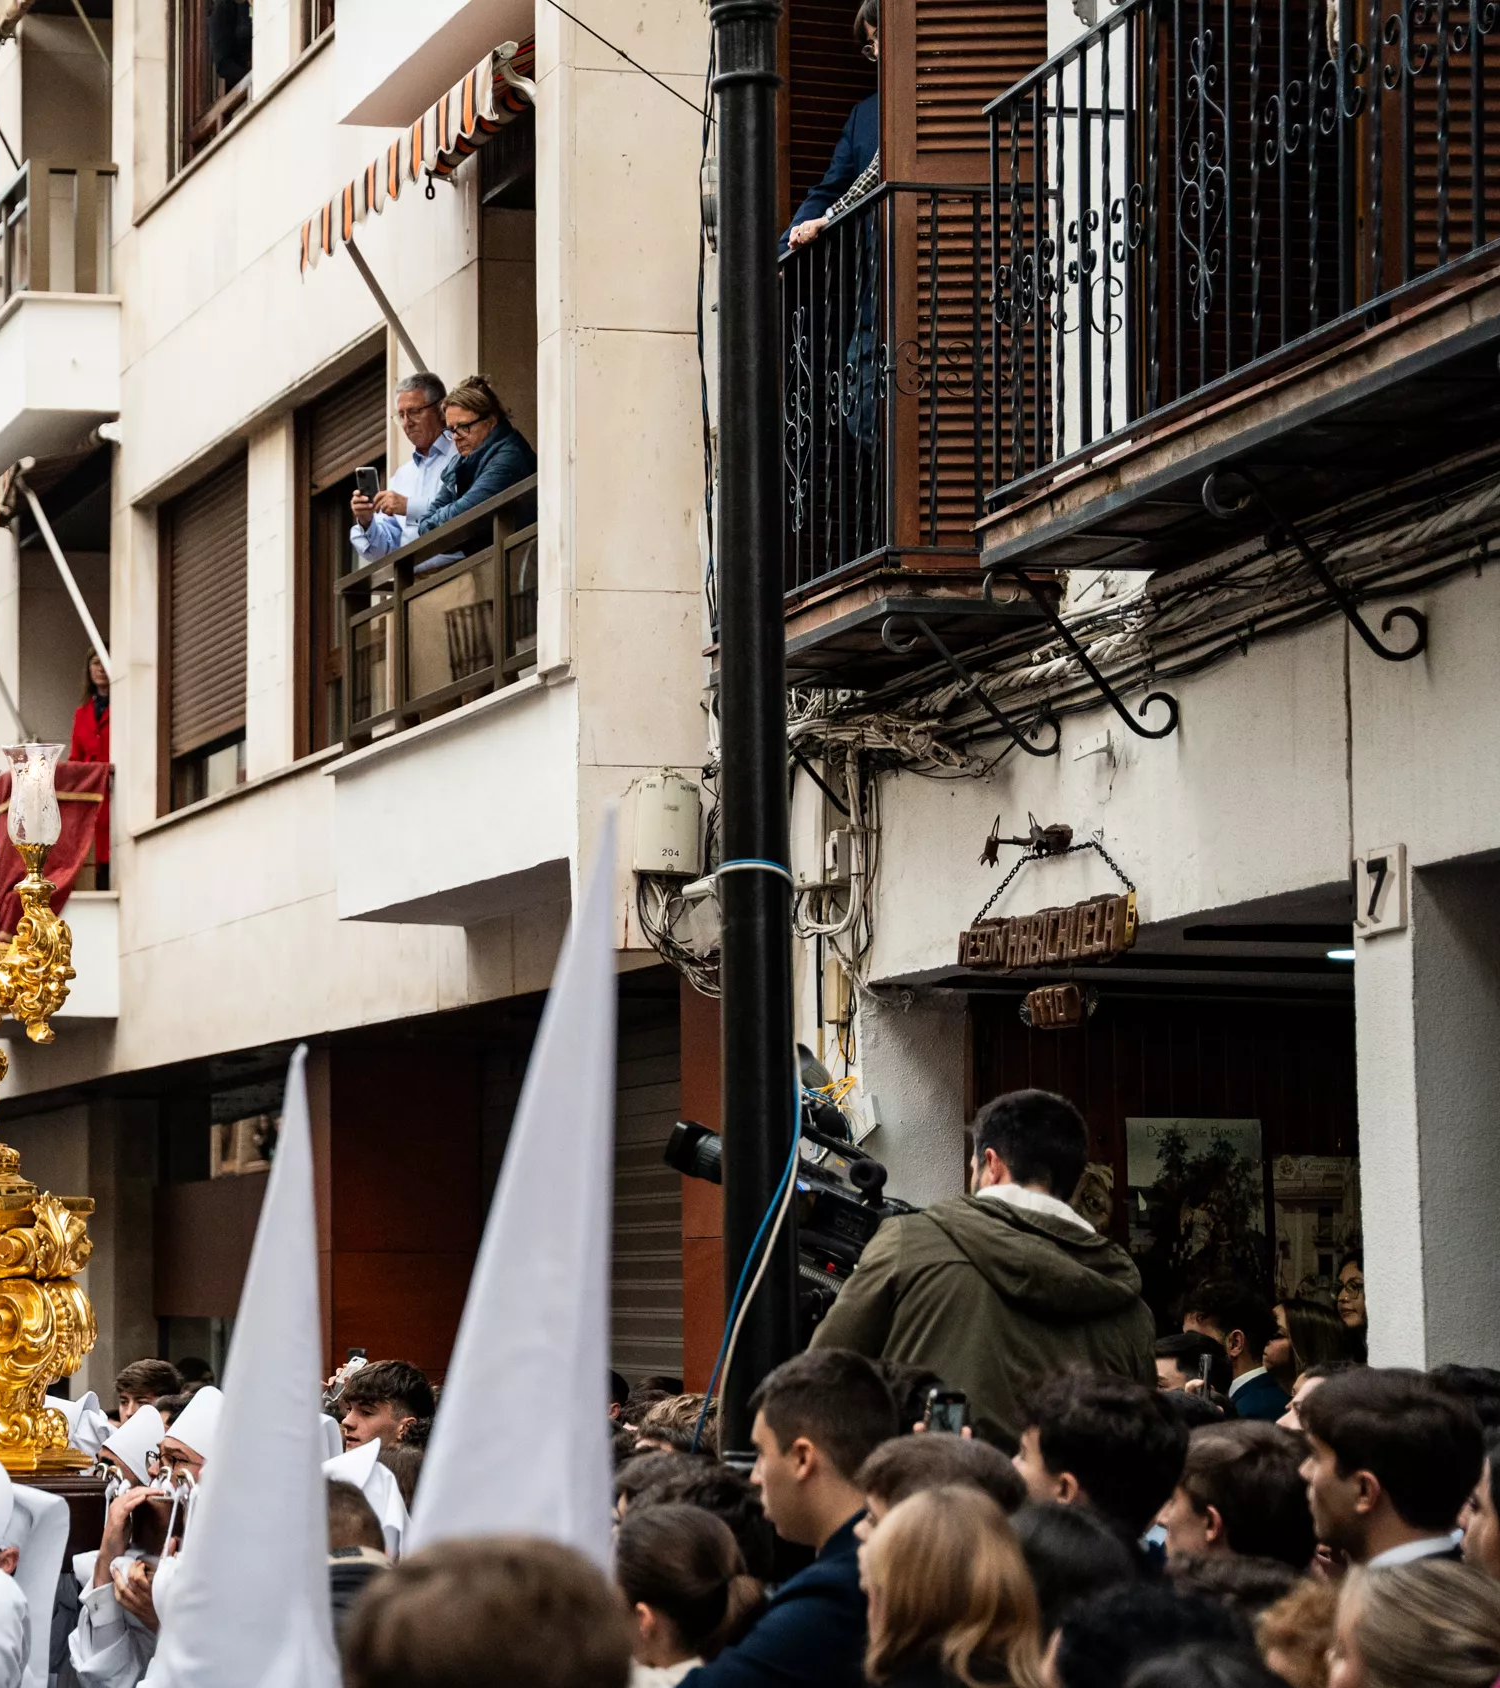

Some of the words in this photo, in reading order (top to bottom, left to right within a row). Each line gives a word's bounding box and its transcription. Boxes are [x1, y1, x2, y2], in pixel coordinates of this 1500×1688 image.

[661, 848, 680, 857] 204
[1006, 897, 1118, 968] HABICHUELA
[1146, 1125, 1193, 1138] DOMGO
